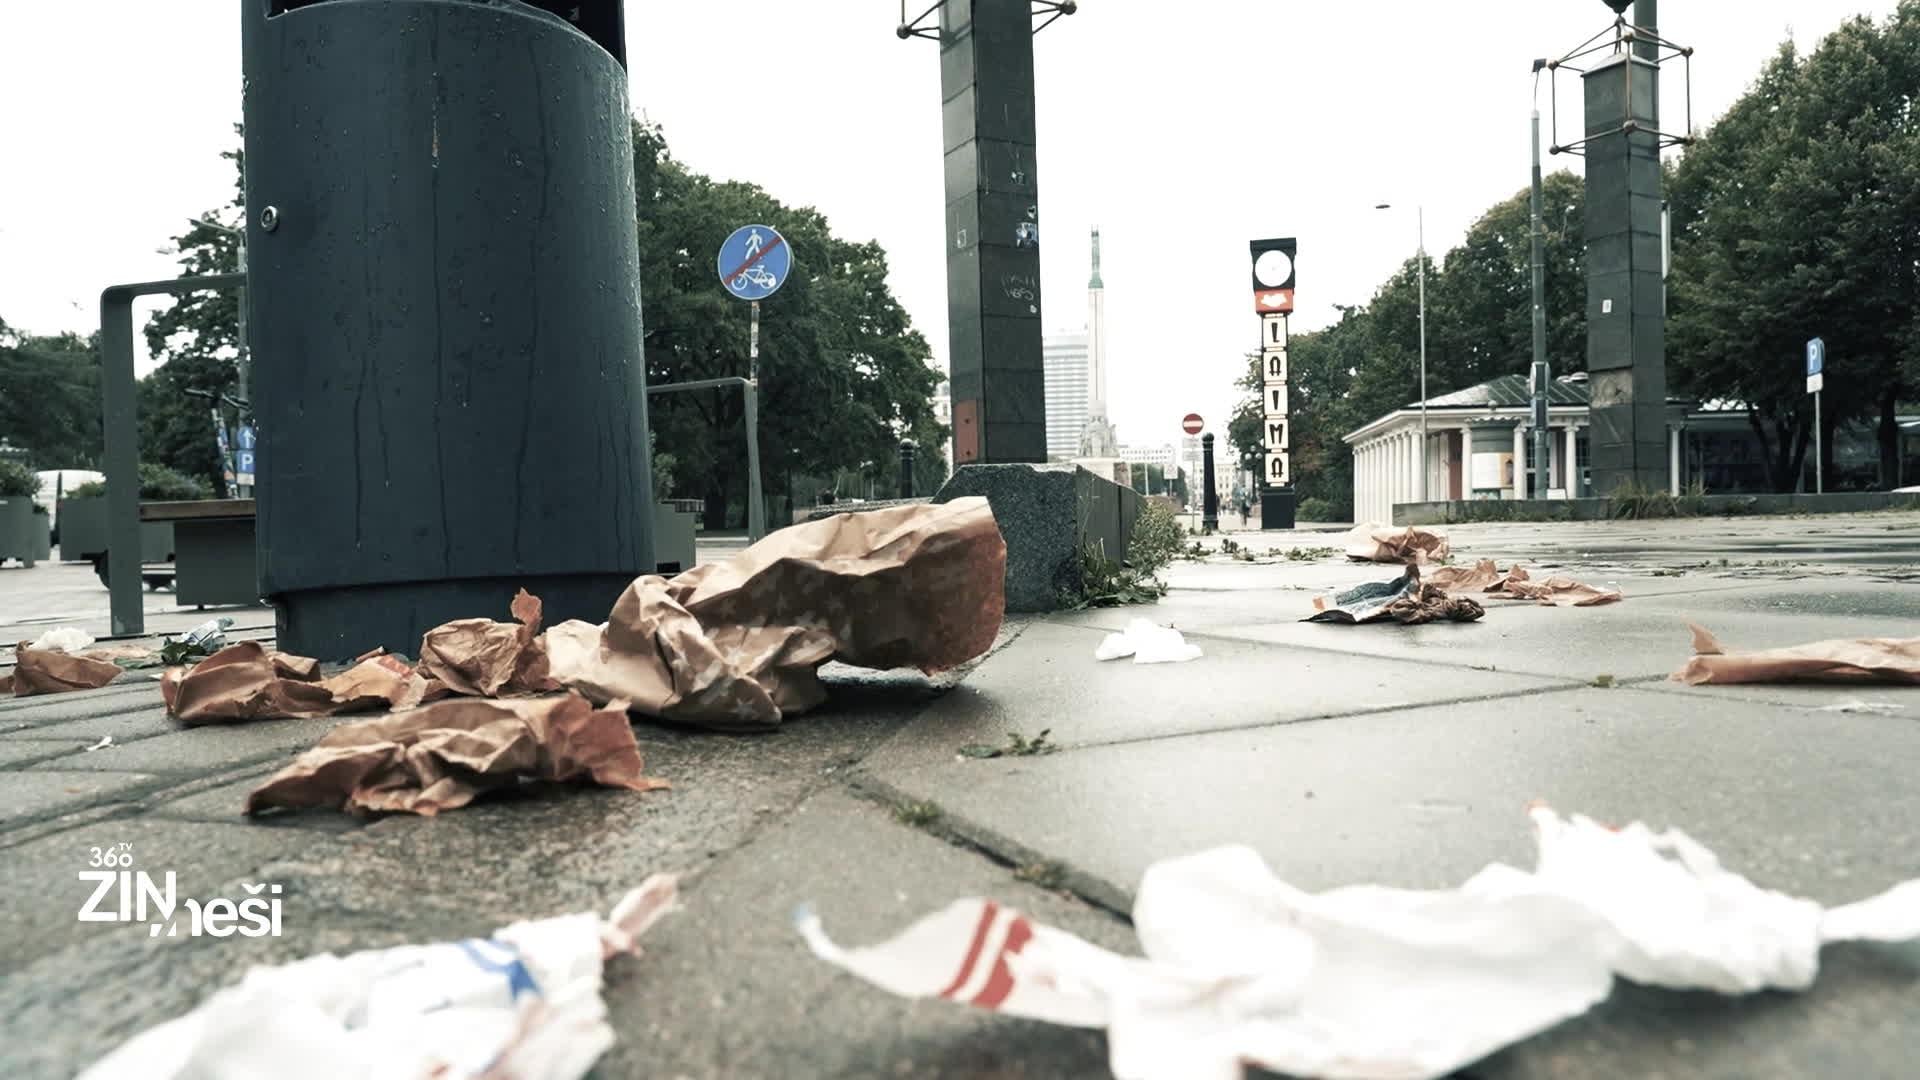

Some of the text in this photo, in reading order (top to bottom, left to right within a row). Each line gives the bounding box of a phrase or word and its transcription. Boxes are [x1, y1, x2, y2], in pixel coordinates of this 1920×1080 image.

[1810, 344, 1818, 370] P
[1269, 322, 1284, 478] LAIMA
[241, 453, 254, 471] P
